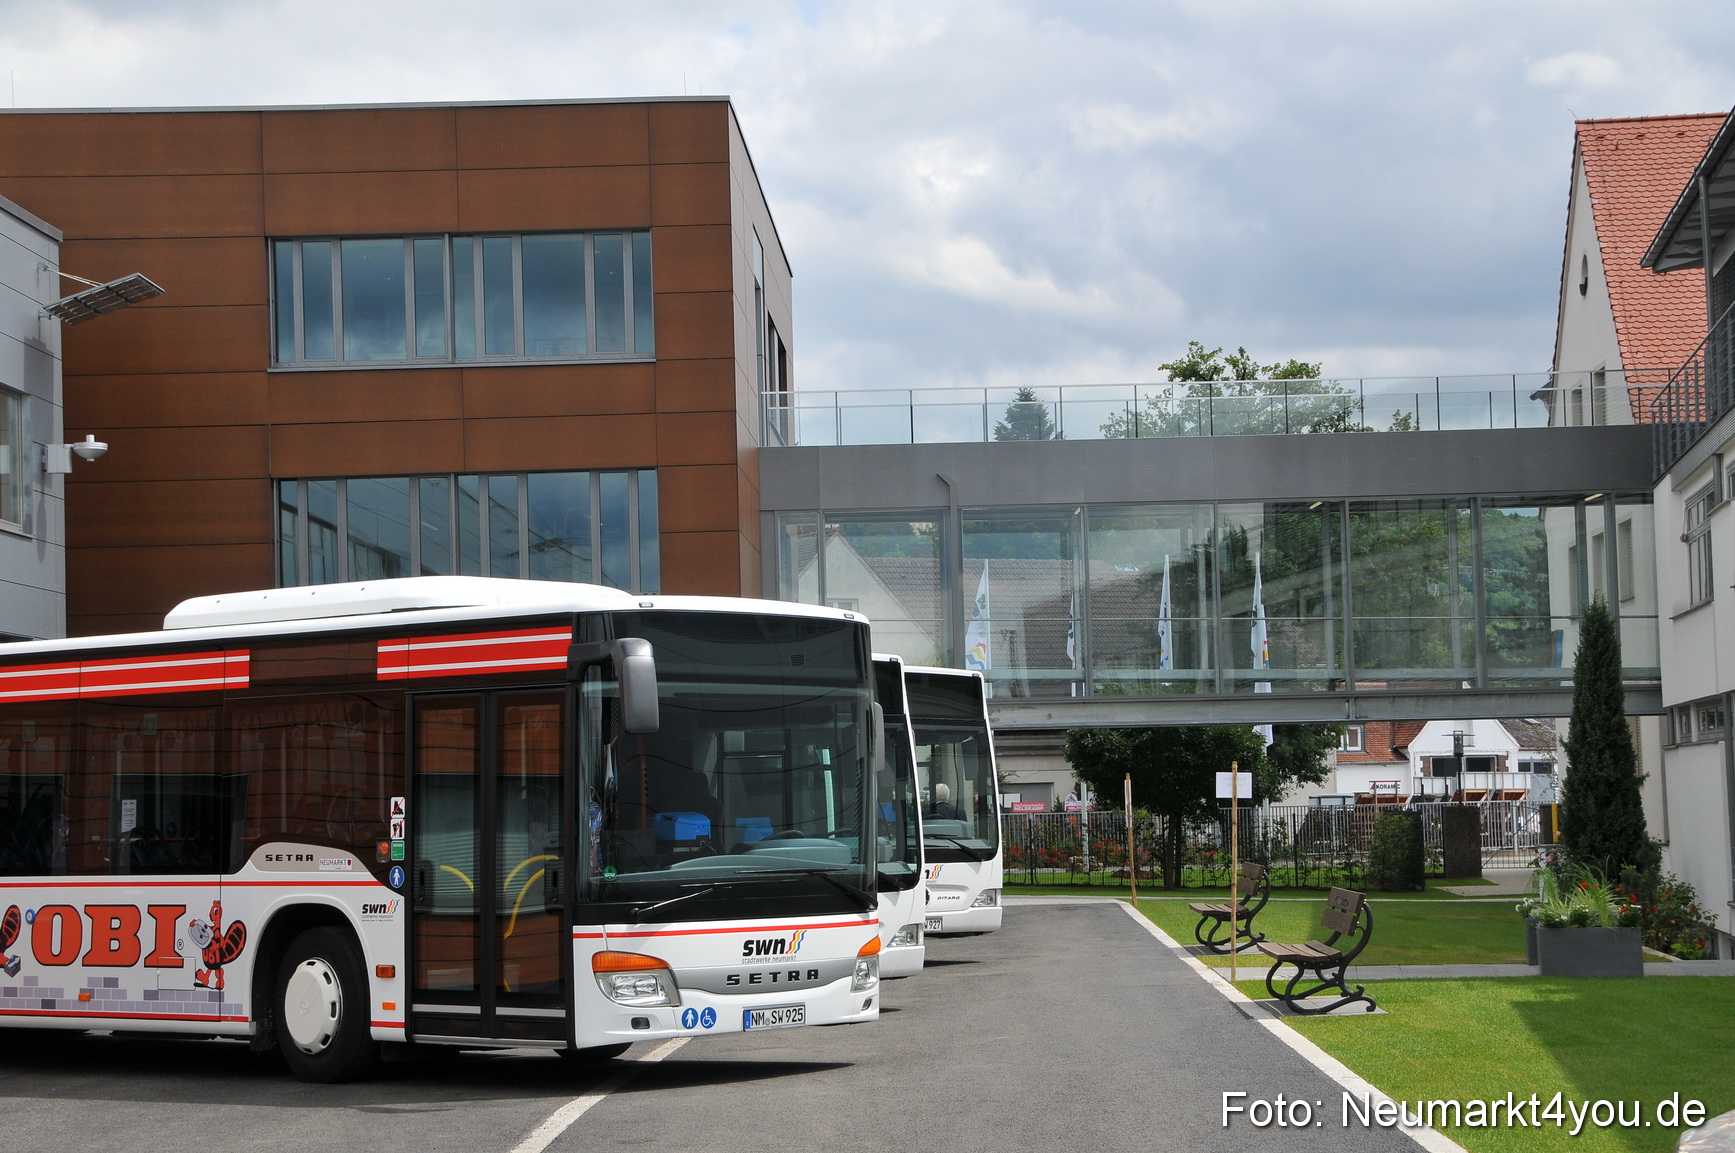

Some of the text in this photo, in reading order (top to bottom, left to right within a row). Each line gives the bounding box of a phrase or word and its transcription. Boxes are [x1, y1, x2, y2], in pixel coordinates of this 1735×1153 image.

[265, 854, 314, 862] SETRA
[361, 903, 387, 914] swn
[929, 920, 941, 930] 927
[31, 904, 187, 968] OBI
[742, 938, 786, 956] swn
[741, 955, 797, 965] stadtwerke neumarkt
[726, 969, 819, 986] SETRA
[751, 1007, 804, 1026] NM SW 925
